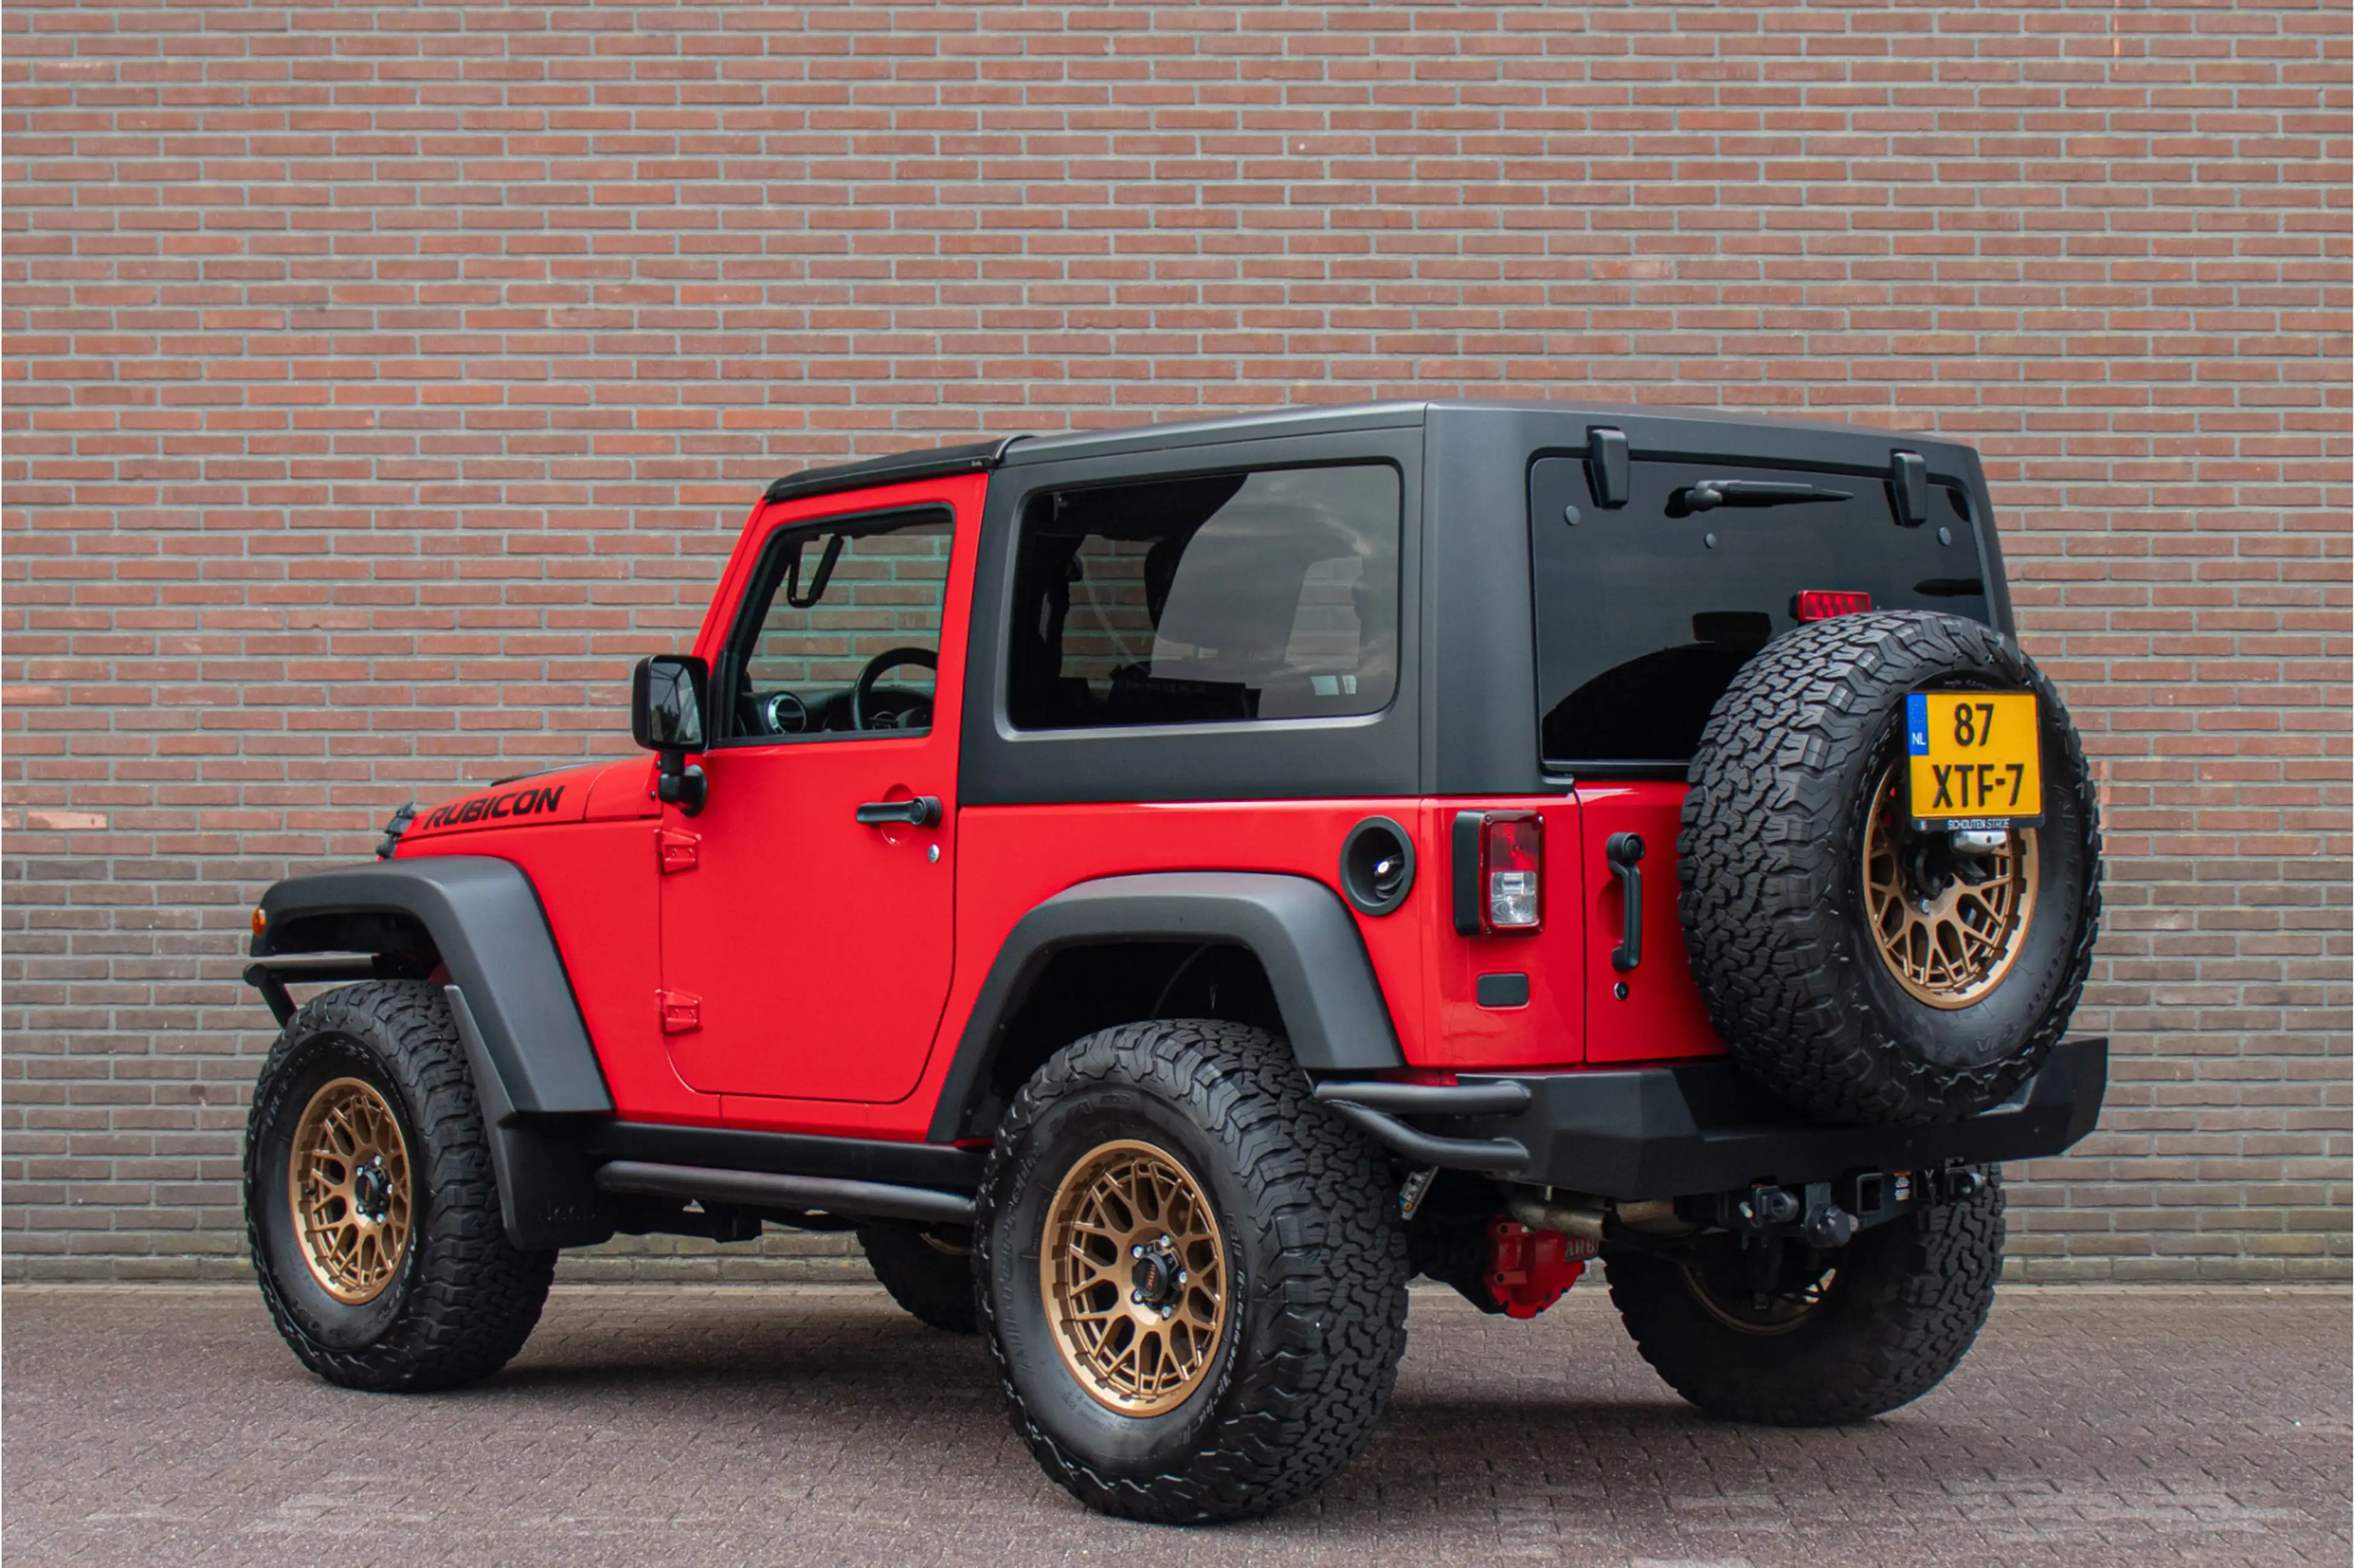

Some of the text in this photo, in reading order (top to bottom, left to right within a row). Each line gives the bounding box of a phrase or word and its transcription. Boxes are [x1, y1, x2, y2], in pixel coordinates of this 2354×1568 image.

[1912, 733, 1926, 745] NL
[1954, 703, 1994, 746] 87
[423, 785, 565, 829] RUBICON
[1932, 764, 2024, 808] XTF-7
[1947, 819, 1986, 829] SCHOUTEN
